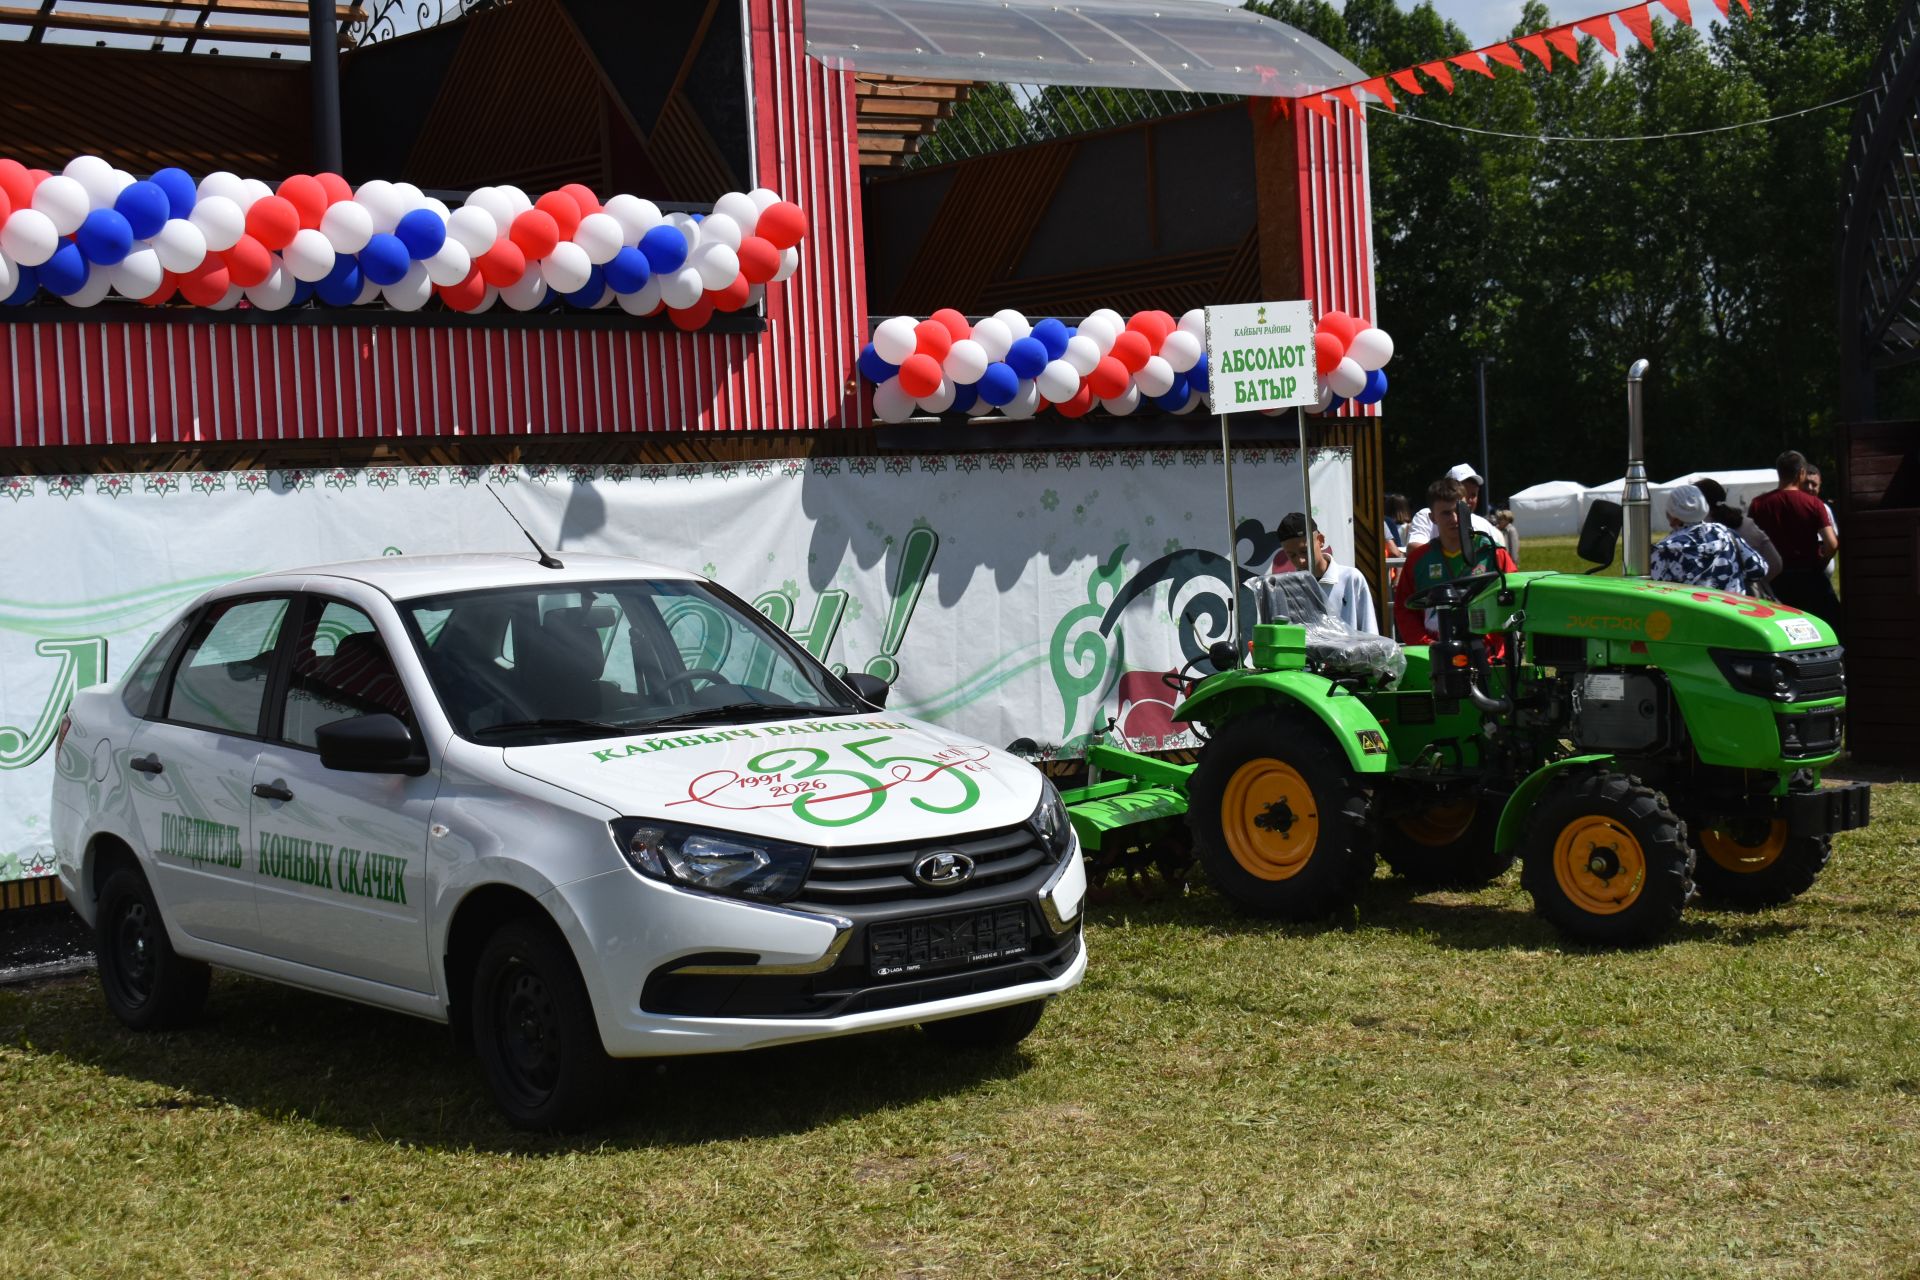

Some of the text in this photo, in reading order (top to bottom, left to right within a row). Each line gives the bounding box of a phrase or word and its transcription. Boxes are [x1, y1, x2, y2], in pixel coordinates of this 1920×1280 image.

[1234, 324, 1292, 337] КАЙБЫЧ РАЙОНЫ
[1220, 344, 1306, 374] АБСОЛЮТ
[1234, 376, 1297, 404] БАТЫР
[588, 720, 918, 763] КАЙБЫЧ РАЙОНЫ
[735, 773, 782, 788] 1991
[747, 736, 981, 828] 35
[769, 779, 828, 798] 2026
[161, 812, 409, 905] ПОБЕДИТЕЛЬ КОННЫХ СКАЧЕК
